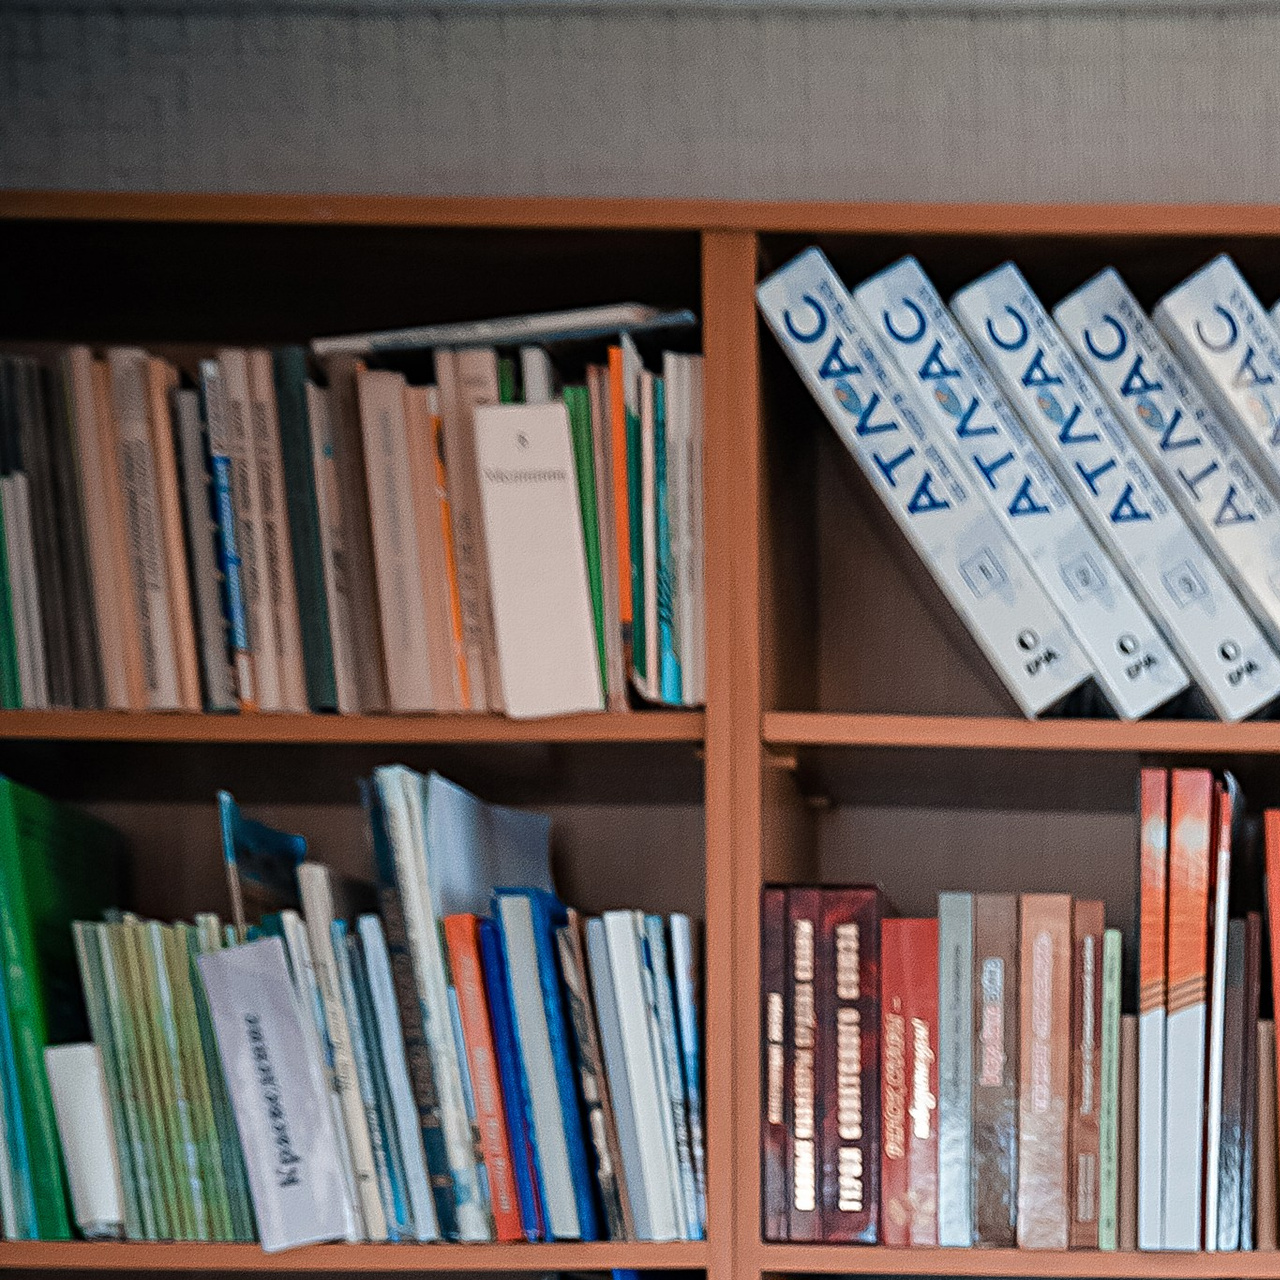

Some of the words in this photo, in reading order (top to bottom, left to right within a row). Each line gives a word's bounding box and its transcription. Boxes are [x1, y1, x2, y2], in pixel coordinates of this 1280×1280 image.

[782, 292, 951, 521] АТЛАС
[883, 294, 1050, 521] АТЛАС
[984, 301, 1153, 526] АТЛАС
[1082, 309, 1255, 528] АТЛАС
[836, 922, 861, 999] СОЮЗА
[837, 1008, 862, 1139] СОВЕТСКОГО
